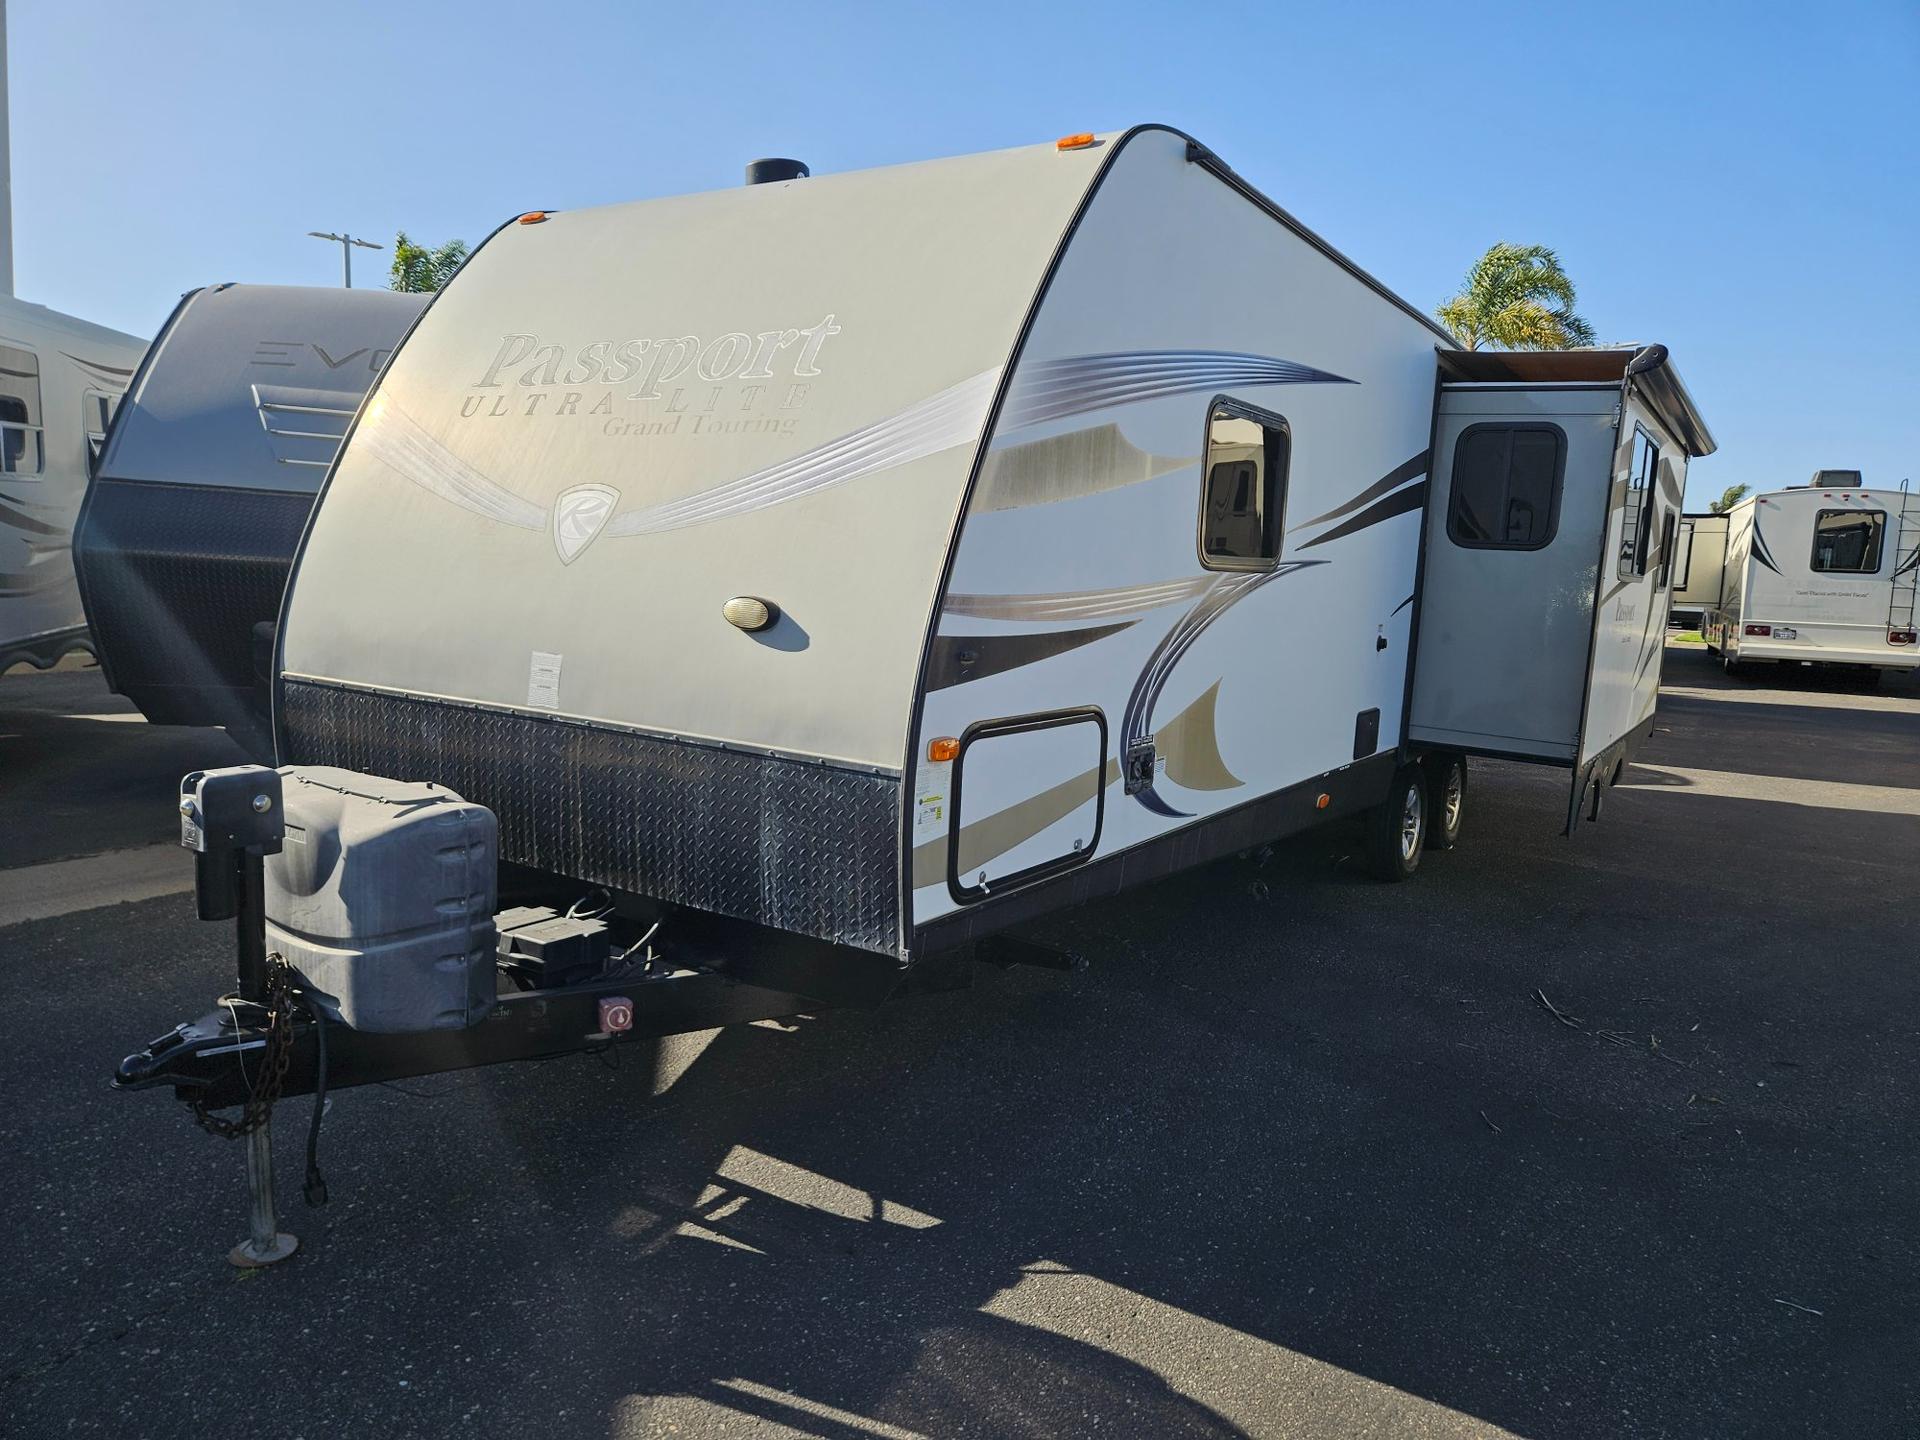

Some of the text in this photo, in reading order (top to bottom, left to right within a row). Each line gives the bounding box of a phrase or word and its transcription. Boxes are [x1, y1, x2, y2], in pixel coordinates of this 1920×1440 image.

[472, 313, 841, 400] Passport
[460, 383, 813, 418] ULTRA LITE
[602, 413, 801, 437] Grand Touring
